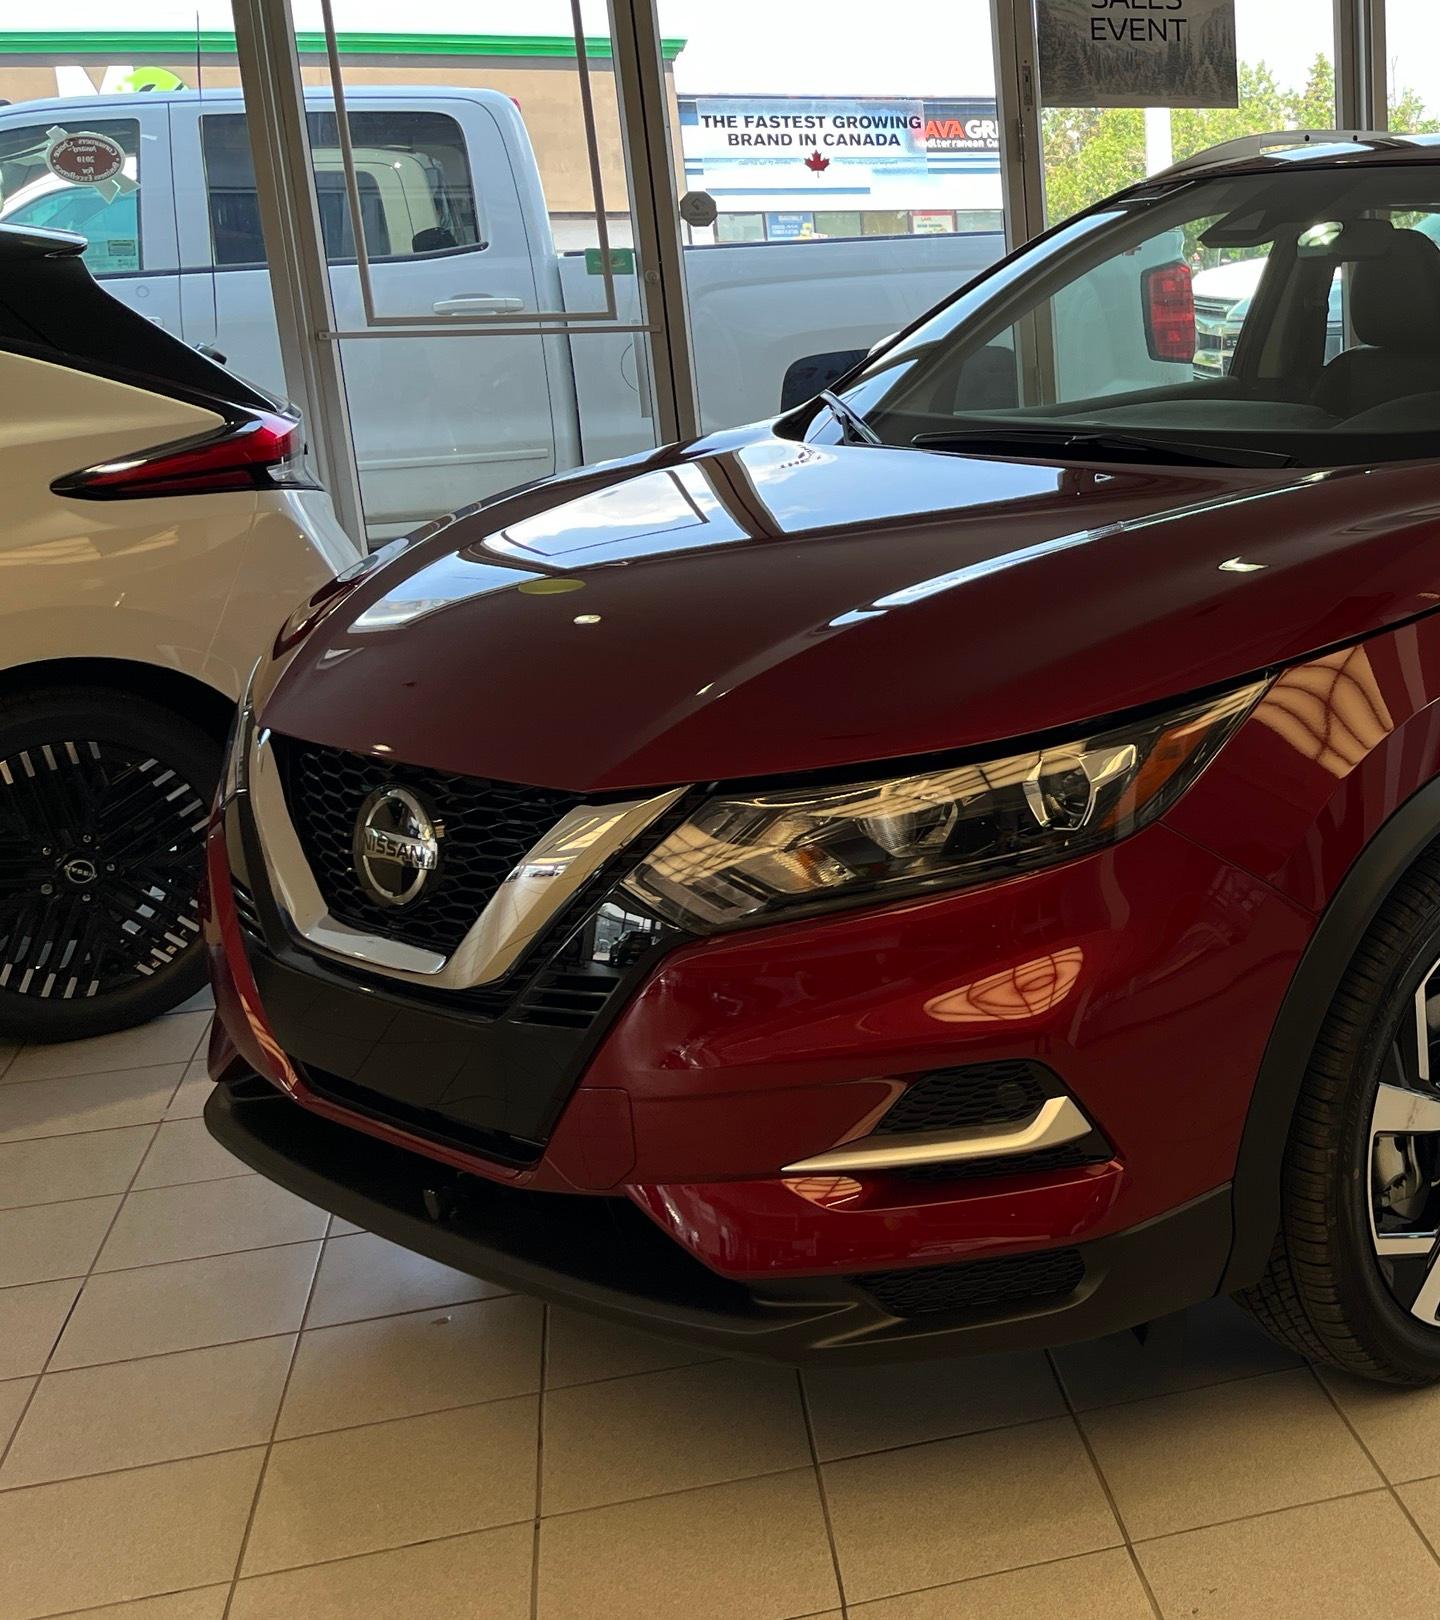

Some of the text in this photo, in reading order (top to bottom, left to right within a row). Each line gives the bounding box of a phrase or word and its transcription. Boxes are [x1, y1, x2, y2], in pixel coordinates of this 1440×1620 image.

[1090, 17, 1187, 41] EVENT
[701, 115, 922, 130] THE FASTEST GROWING
[925, 118, 965, 140] AVA
[727, 133, 901, 146] BRAND IN CANADA
[917, 138, 985, 149] diterranean
[364, 832, 424, 864] NISSAN
